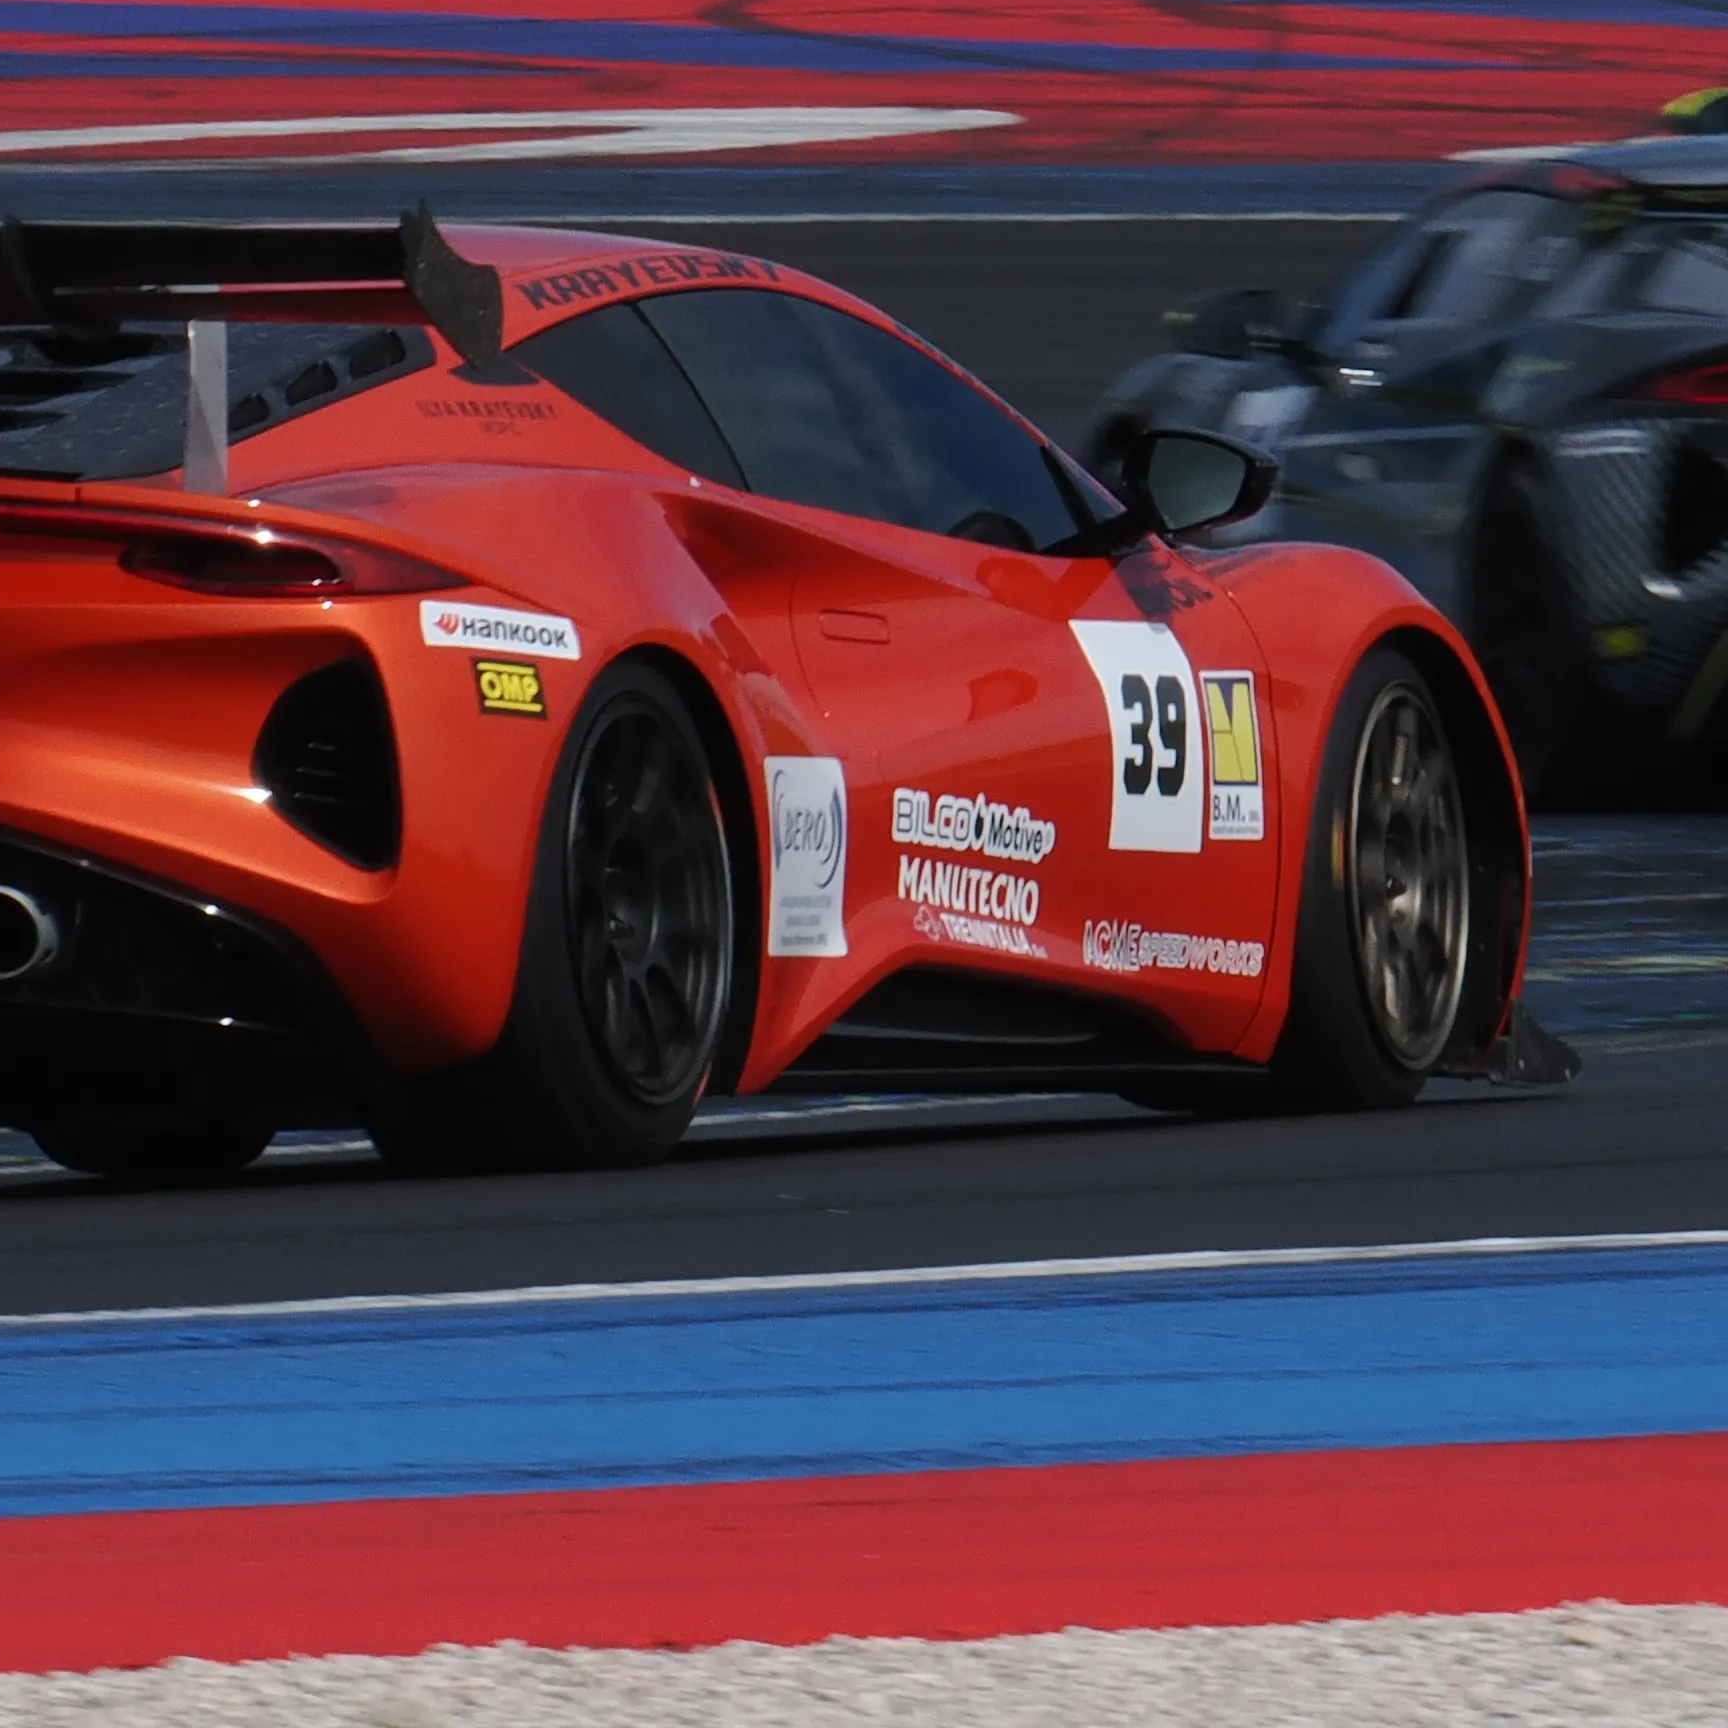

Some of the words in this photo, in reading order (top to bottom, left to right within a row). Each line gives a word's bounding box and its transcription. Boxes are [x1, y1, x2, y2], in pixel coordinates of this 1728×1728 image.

[514, 254, 782, 311] KRAYEVSKY
[480, 671, 539, 702] OMP
[1121, 674, 1186, 797] 39
[894, 794, 972, 846] BILCO
[986, 806, 1045, 858] Motive
[1212, 793, 1246, 823] B.M.
[898, 854, 1039, 925] MANUTECNO
[1083, 919, 1141, 972] ACME
[1138, 931, 1265, 977] SPEEDWORKS
